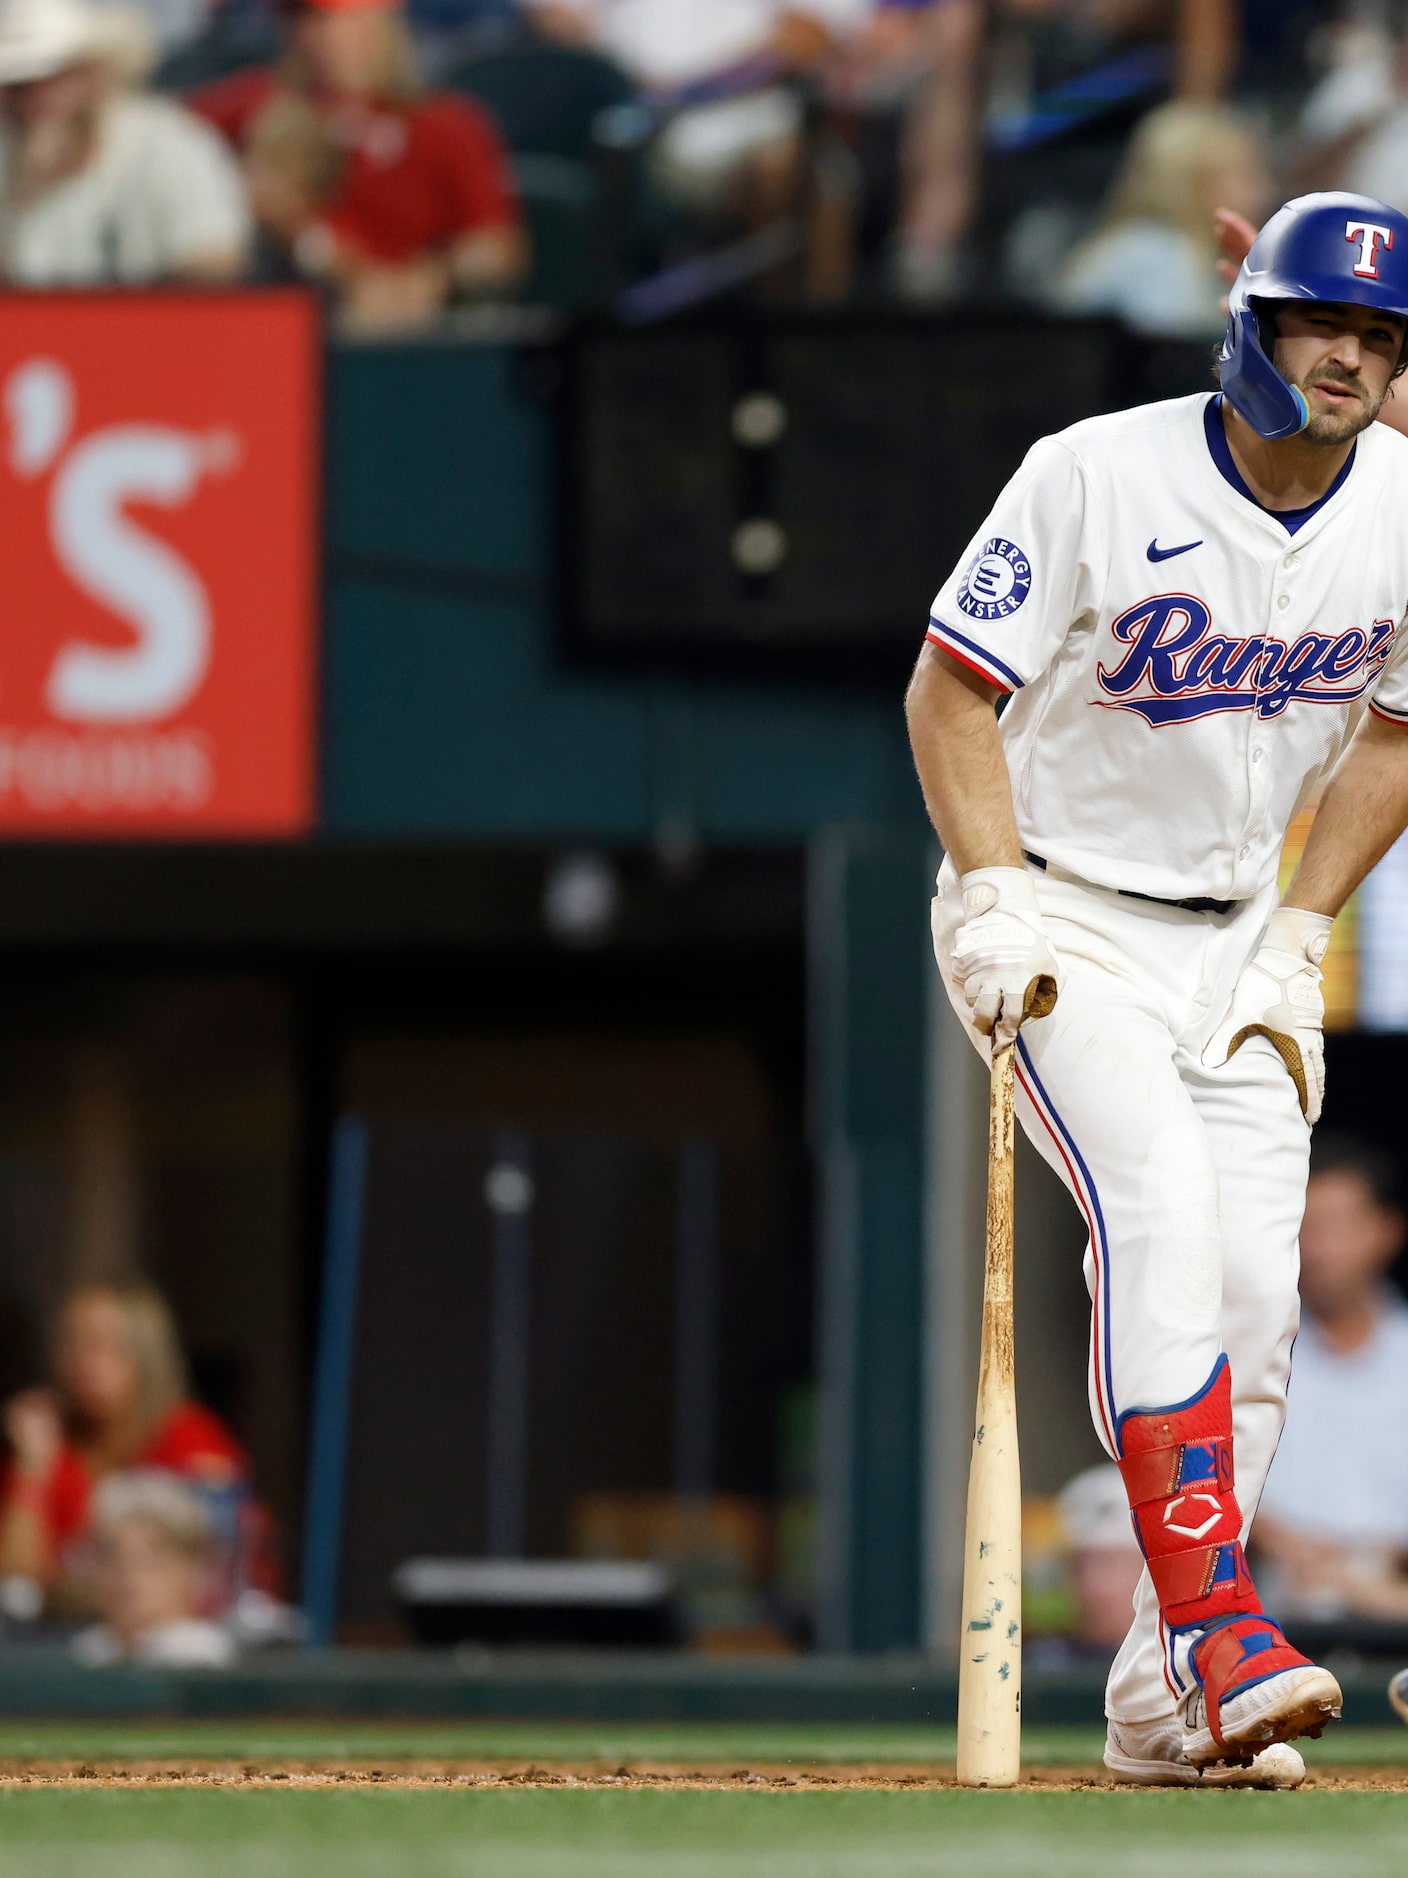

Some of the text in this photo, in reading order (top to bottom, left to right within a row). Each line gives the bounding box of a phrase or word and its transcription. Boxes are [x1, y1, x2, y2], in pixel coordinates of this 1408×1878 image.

[1345, 220, 1394, 279] T
[978, 539, 1031, 588] ENERGY
[958, 571, 1021, 619] TRANSFER
